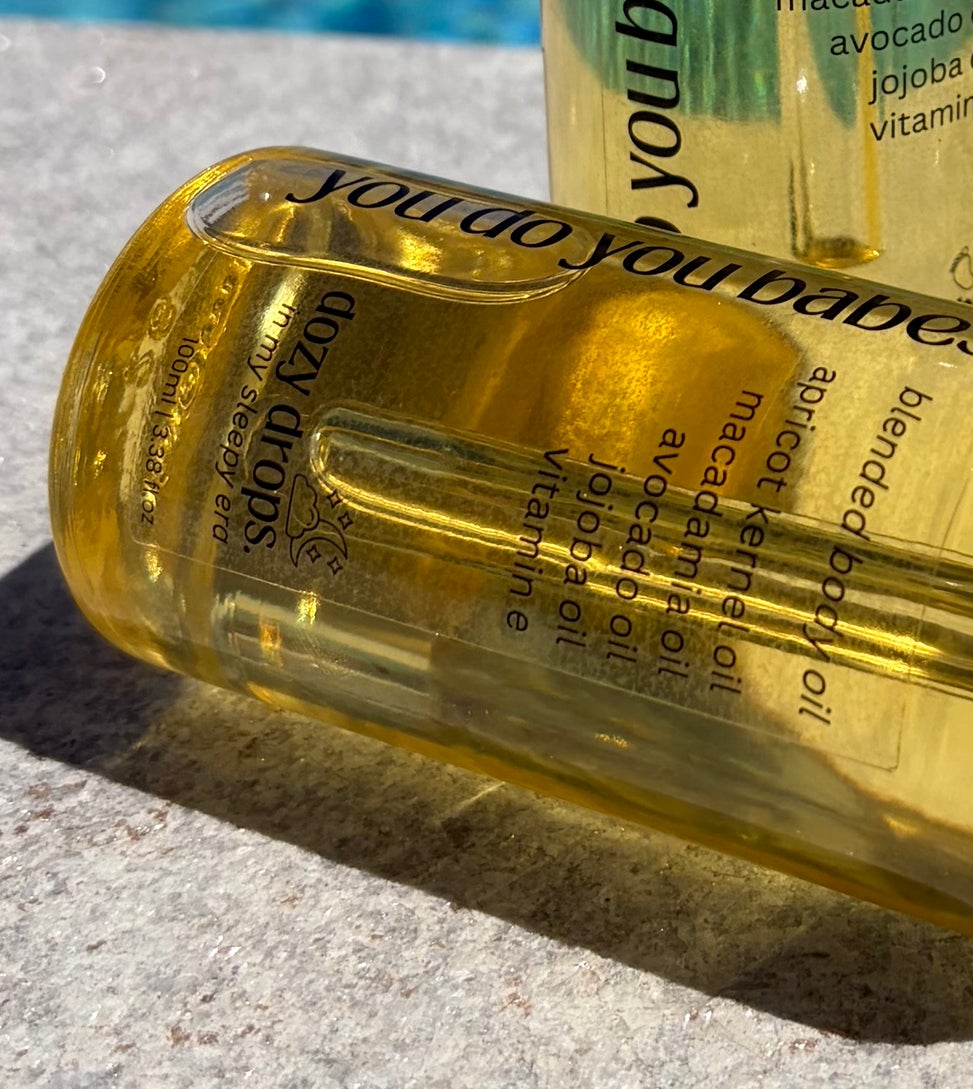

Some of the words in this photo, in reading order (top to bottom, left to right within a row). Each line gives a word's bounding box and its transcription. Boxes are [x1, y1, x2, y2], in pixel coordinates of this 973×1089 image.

[830, 12, 963, 56] avocado
[868, 58, 963, 106] jojoba
[625, 60, 699, 208] you
[285, 169, 463, 223] you
[459, 206, 573, 249] do
[557, 232, 742, 291] you
[246, 333, 282, 383] my
[272, 303, 302, 329] in
[275, 290, 356, 397] dozy
[160, 337, 200, 406] 100ml
[145, 423, 170, 475] 3.38
[214, 384, 259, 489] sleepy
[756, 365, 837, 494] apricot
[841, 385, 934, 542] blended
[212, 493, 232, 545] era
[240, 403, 304, 554] drops.
[563, 452, 627, 587] jojoba
[614, 428, 687, 602] avocado
[665, 389, 765, 617] macadamia
[509, 447, 570, 598] vitamin
[717, 502, 782, 634] kernel
[801, 544, 866, 663] body
[506, 610, 530, 633] e
[556, 599, 588, 648] oil
[605, 614, 639, 664] oil
[657, 629, 691, 679] oil
[709, 644, 742, 695] oil
[797, 668, 833, 726] oil
